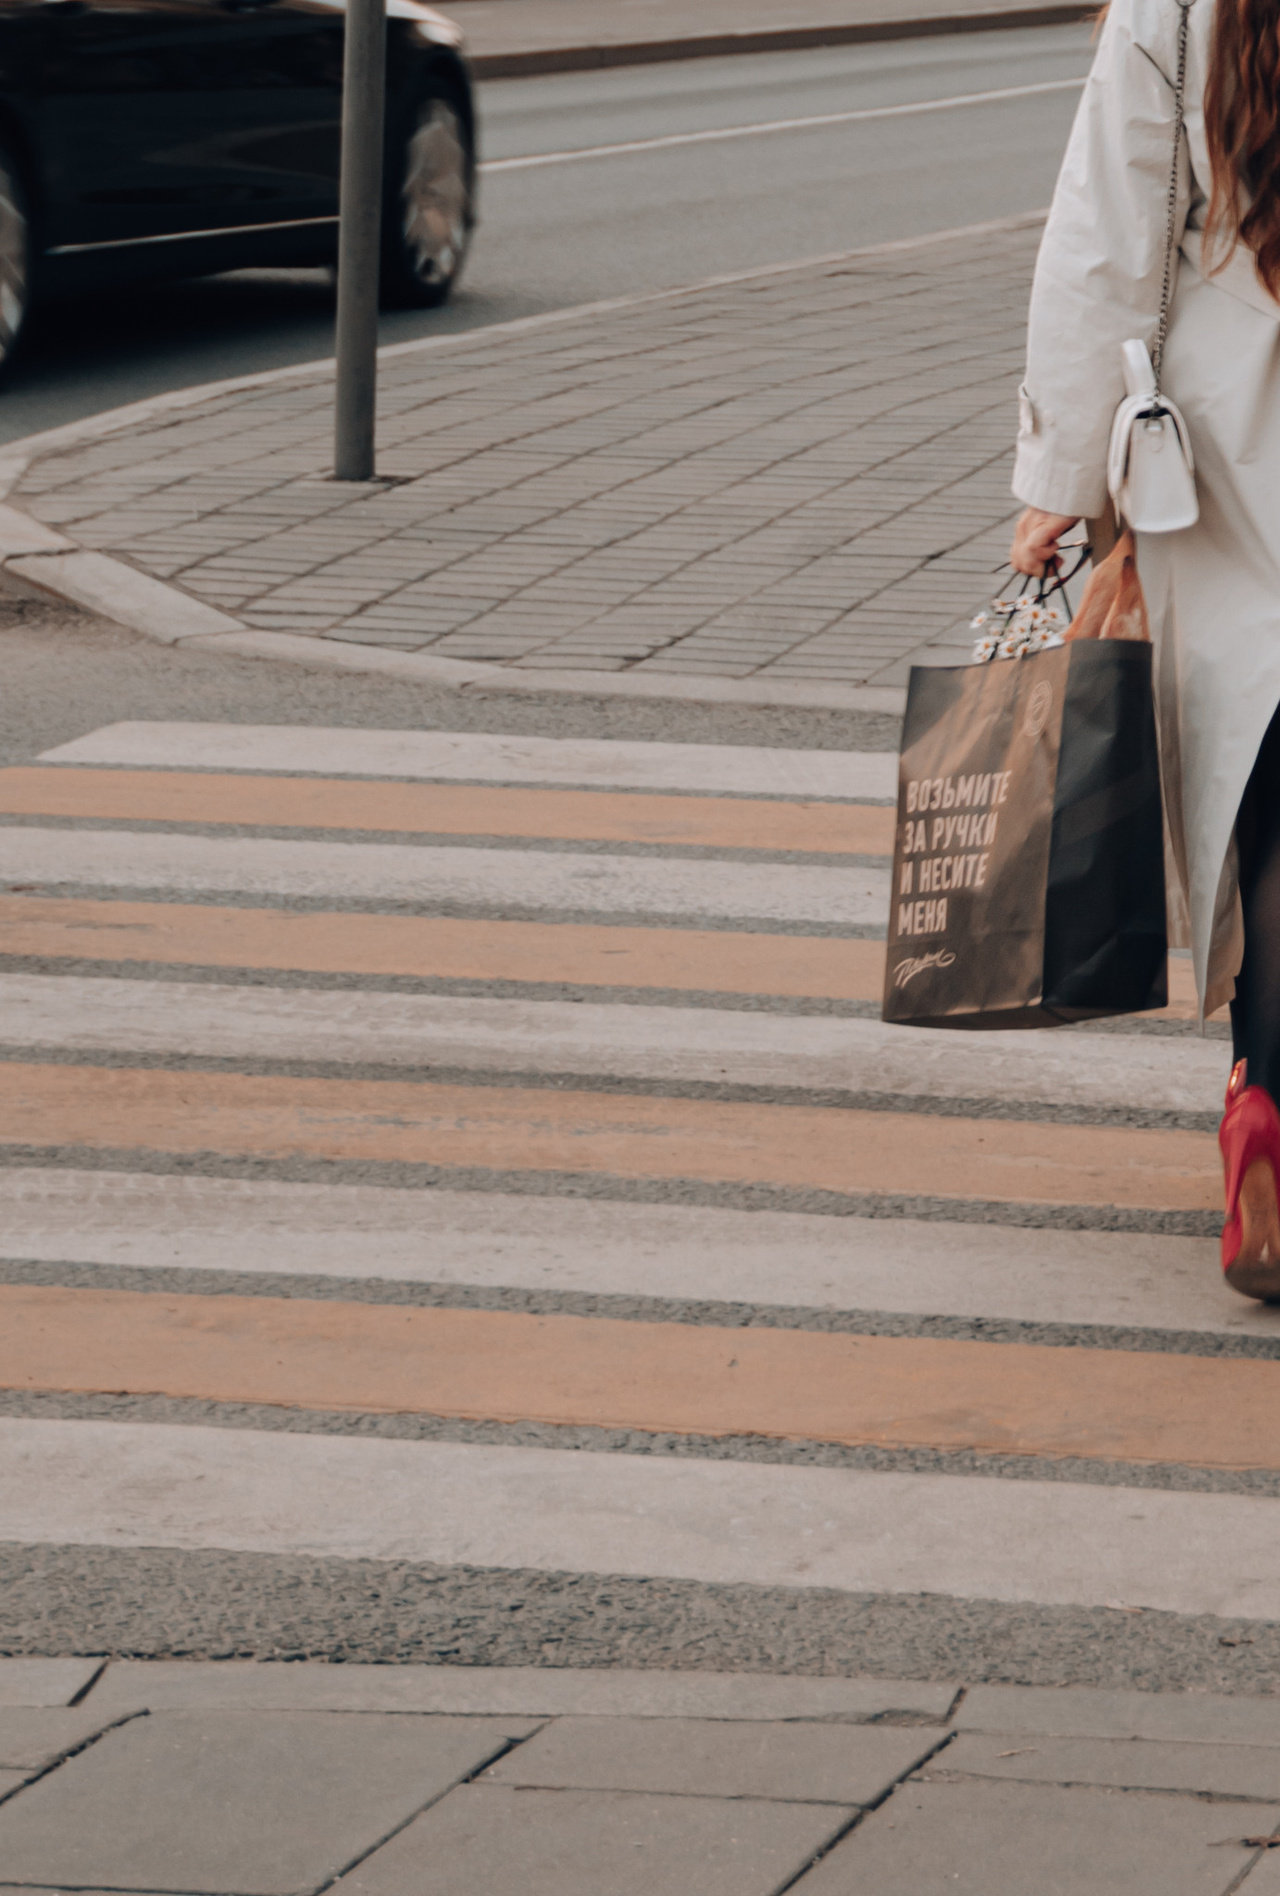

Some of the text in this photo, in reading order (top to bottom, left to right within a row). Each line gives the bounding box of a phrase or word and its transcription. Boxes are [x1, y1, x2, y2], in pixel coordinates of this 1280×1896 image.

[906, 769, 1012, 814] ВОЗЬМИТЕ
[903, 811, 998, 854] ЗА РУЧКИ
[900, 852, 990, 895] И НЕСИТЕ
[897, 897, 948, 936] МЕНЯ
